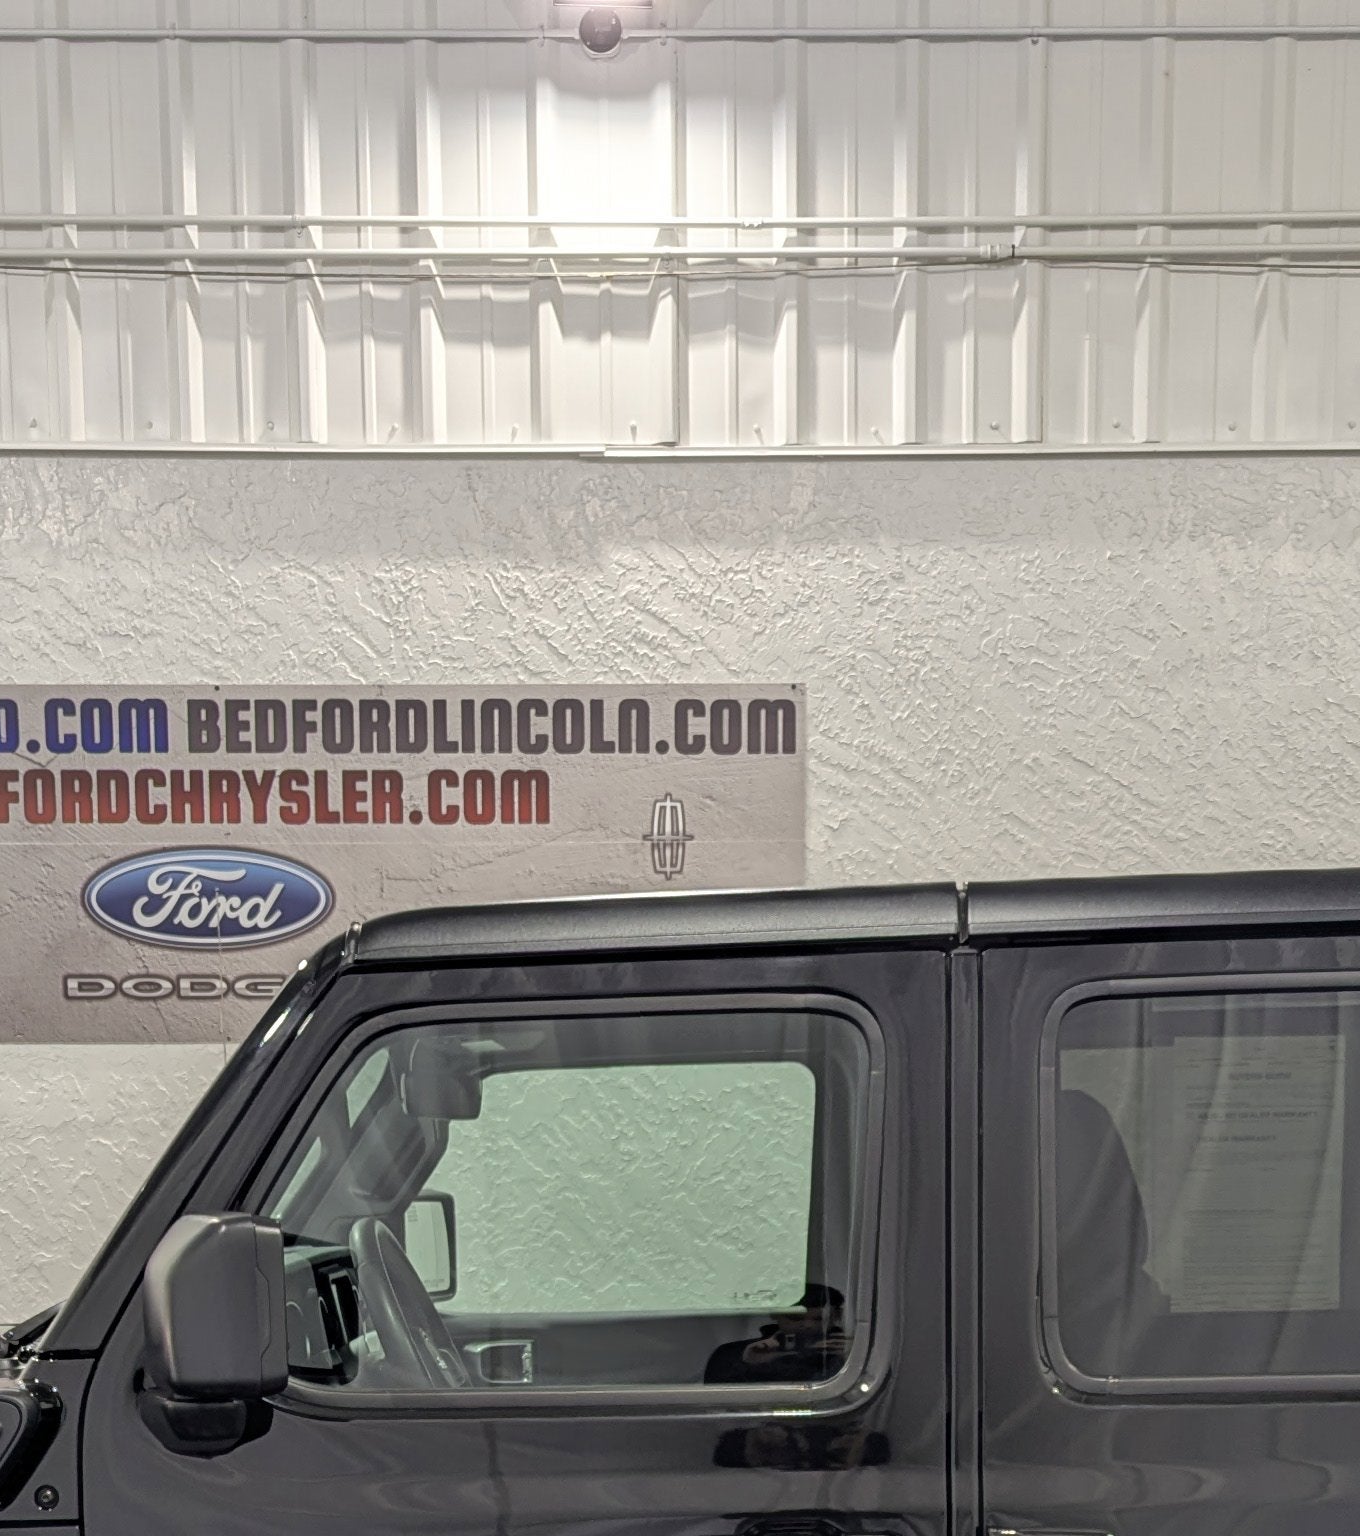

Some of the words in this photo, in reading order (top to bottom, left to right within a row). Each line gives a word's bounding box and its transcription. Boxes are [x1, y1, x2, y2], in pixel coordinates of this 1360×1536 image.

[187, 698, 797, 755] BEDFORDLINCOLN.COM
[132, 865, 285, 929] Ford
[65, 974, 288, 999] DODG
